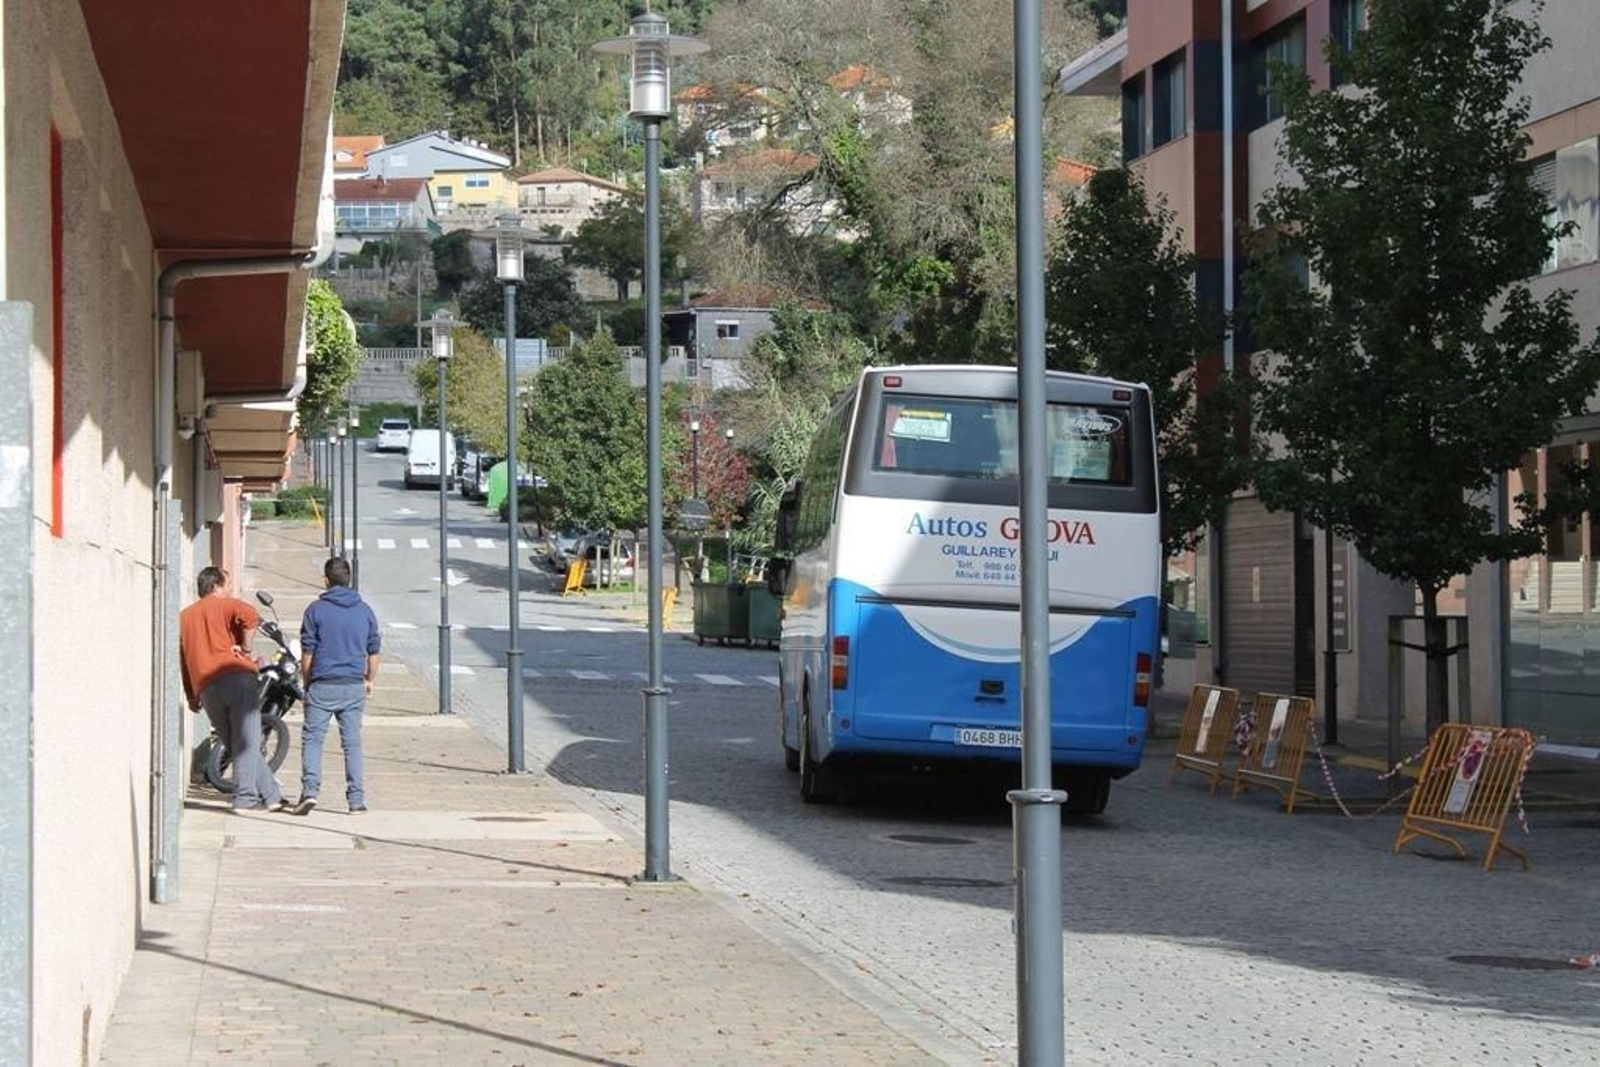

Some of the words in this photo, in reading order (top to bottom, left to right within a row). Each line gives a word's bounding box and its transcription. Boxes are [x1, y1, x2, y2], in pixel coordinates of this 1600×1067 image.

[906, 512, 987, 538] Autos
[942, 544, 1017, 558] GUILLAREY
[963, 730, 996, 744] 0468
